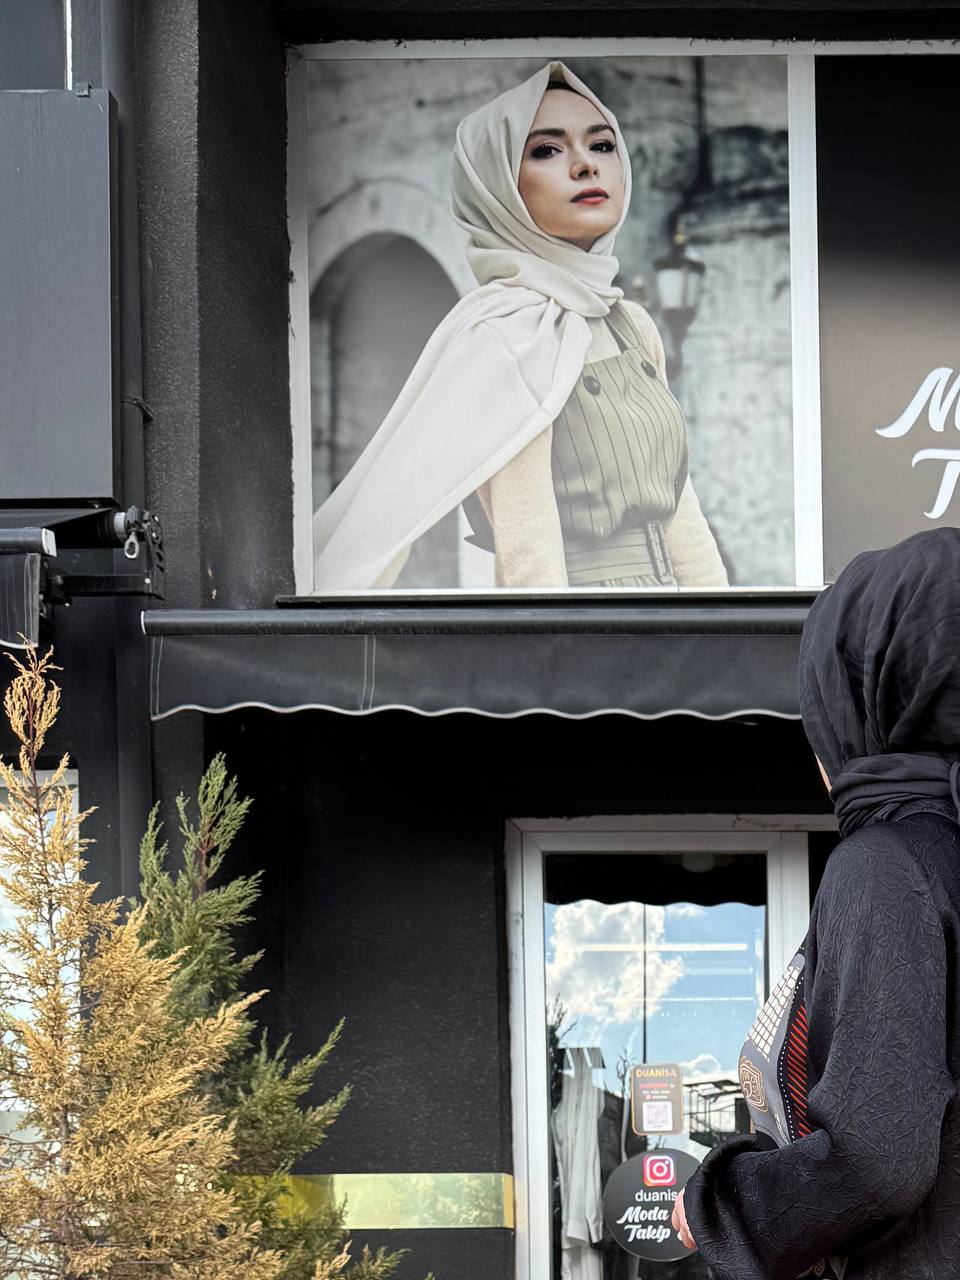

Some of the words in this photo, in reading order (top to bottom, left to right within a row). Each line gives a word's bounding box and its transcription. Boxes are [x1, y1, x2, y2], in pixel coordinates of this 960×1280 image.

[634, 1189, 679, 1202] duanis
[616, 1205, 669, 1224] Moda
[623, 1224, 671, 1243] Takip
